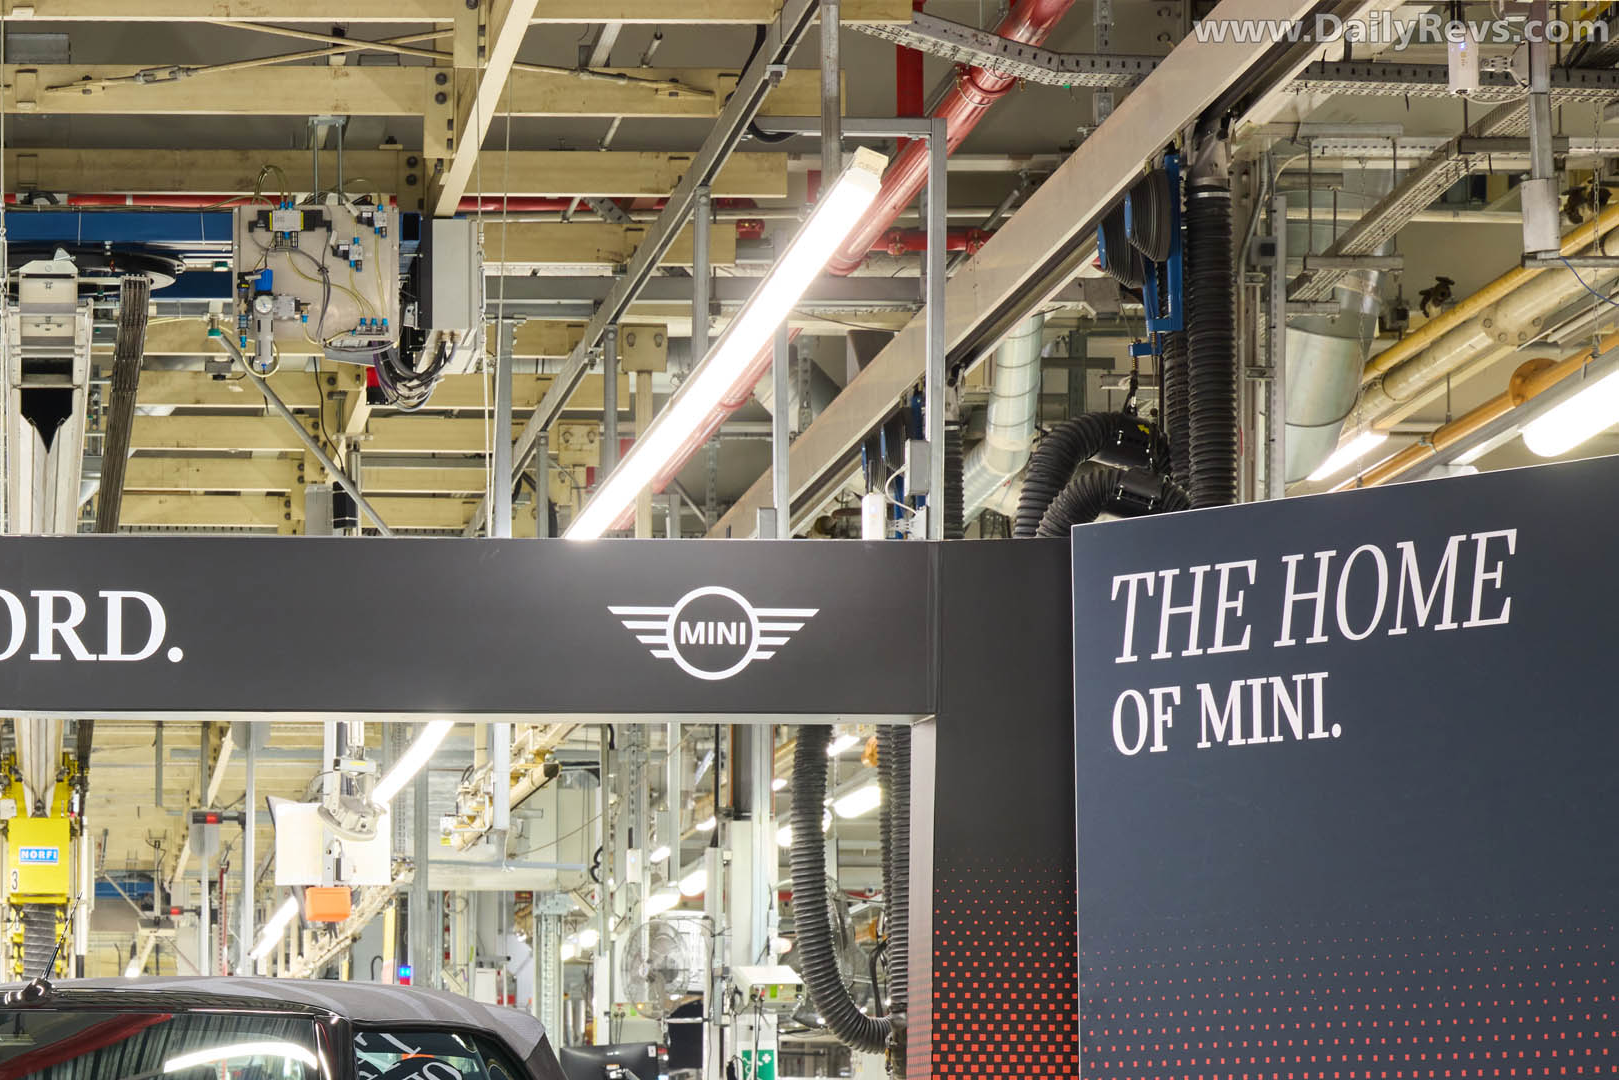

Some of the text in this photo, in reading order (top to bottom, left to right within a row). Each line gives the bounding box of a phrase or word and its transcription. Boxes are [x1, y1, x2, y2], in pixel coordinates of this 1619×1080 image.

[1111, 528, 1518, 664] THE HOME
[679, 620, 747, 646] MINI
[1112, 671, 1342, 756] OF MINI.
[21, 850, 57, 859] NORFI
[11, 870, 19, 890] 3
